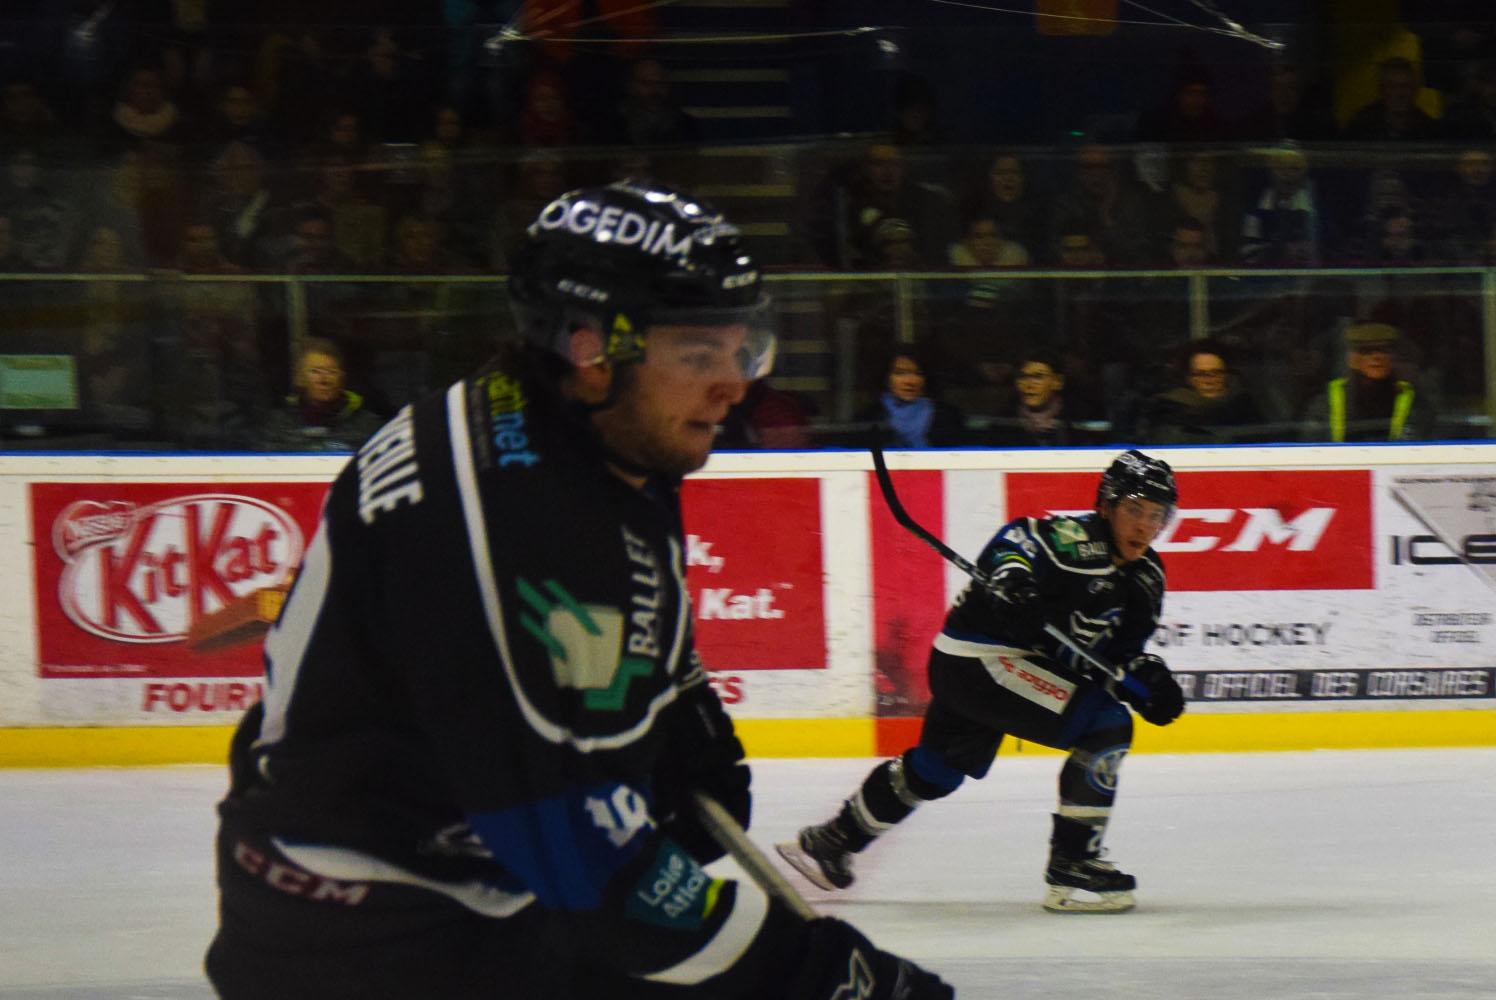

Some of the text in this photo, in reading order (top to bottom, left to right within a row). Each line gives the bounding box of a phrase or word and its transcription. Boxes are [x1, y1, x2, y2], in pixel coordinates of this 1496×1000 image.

[1095, 507, 1339, 553] CM
[103, 502, 281, 635] KitKat
[686, 534, 726, 574] k,
[1203, 621, 1334, 647] HOCKEY
[143, 682, 265, 713] FOUR
